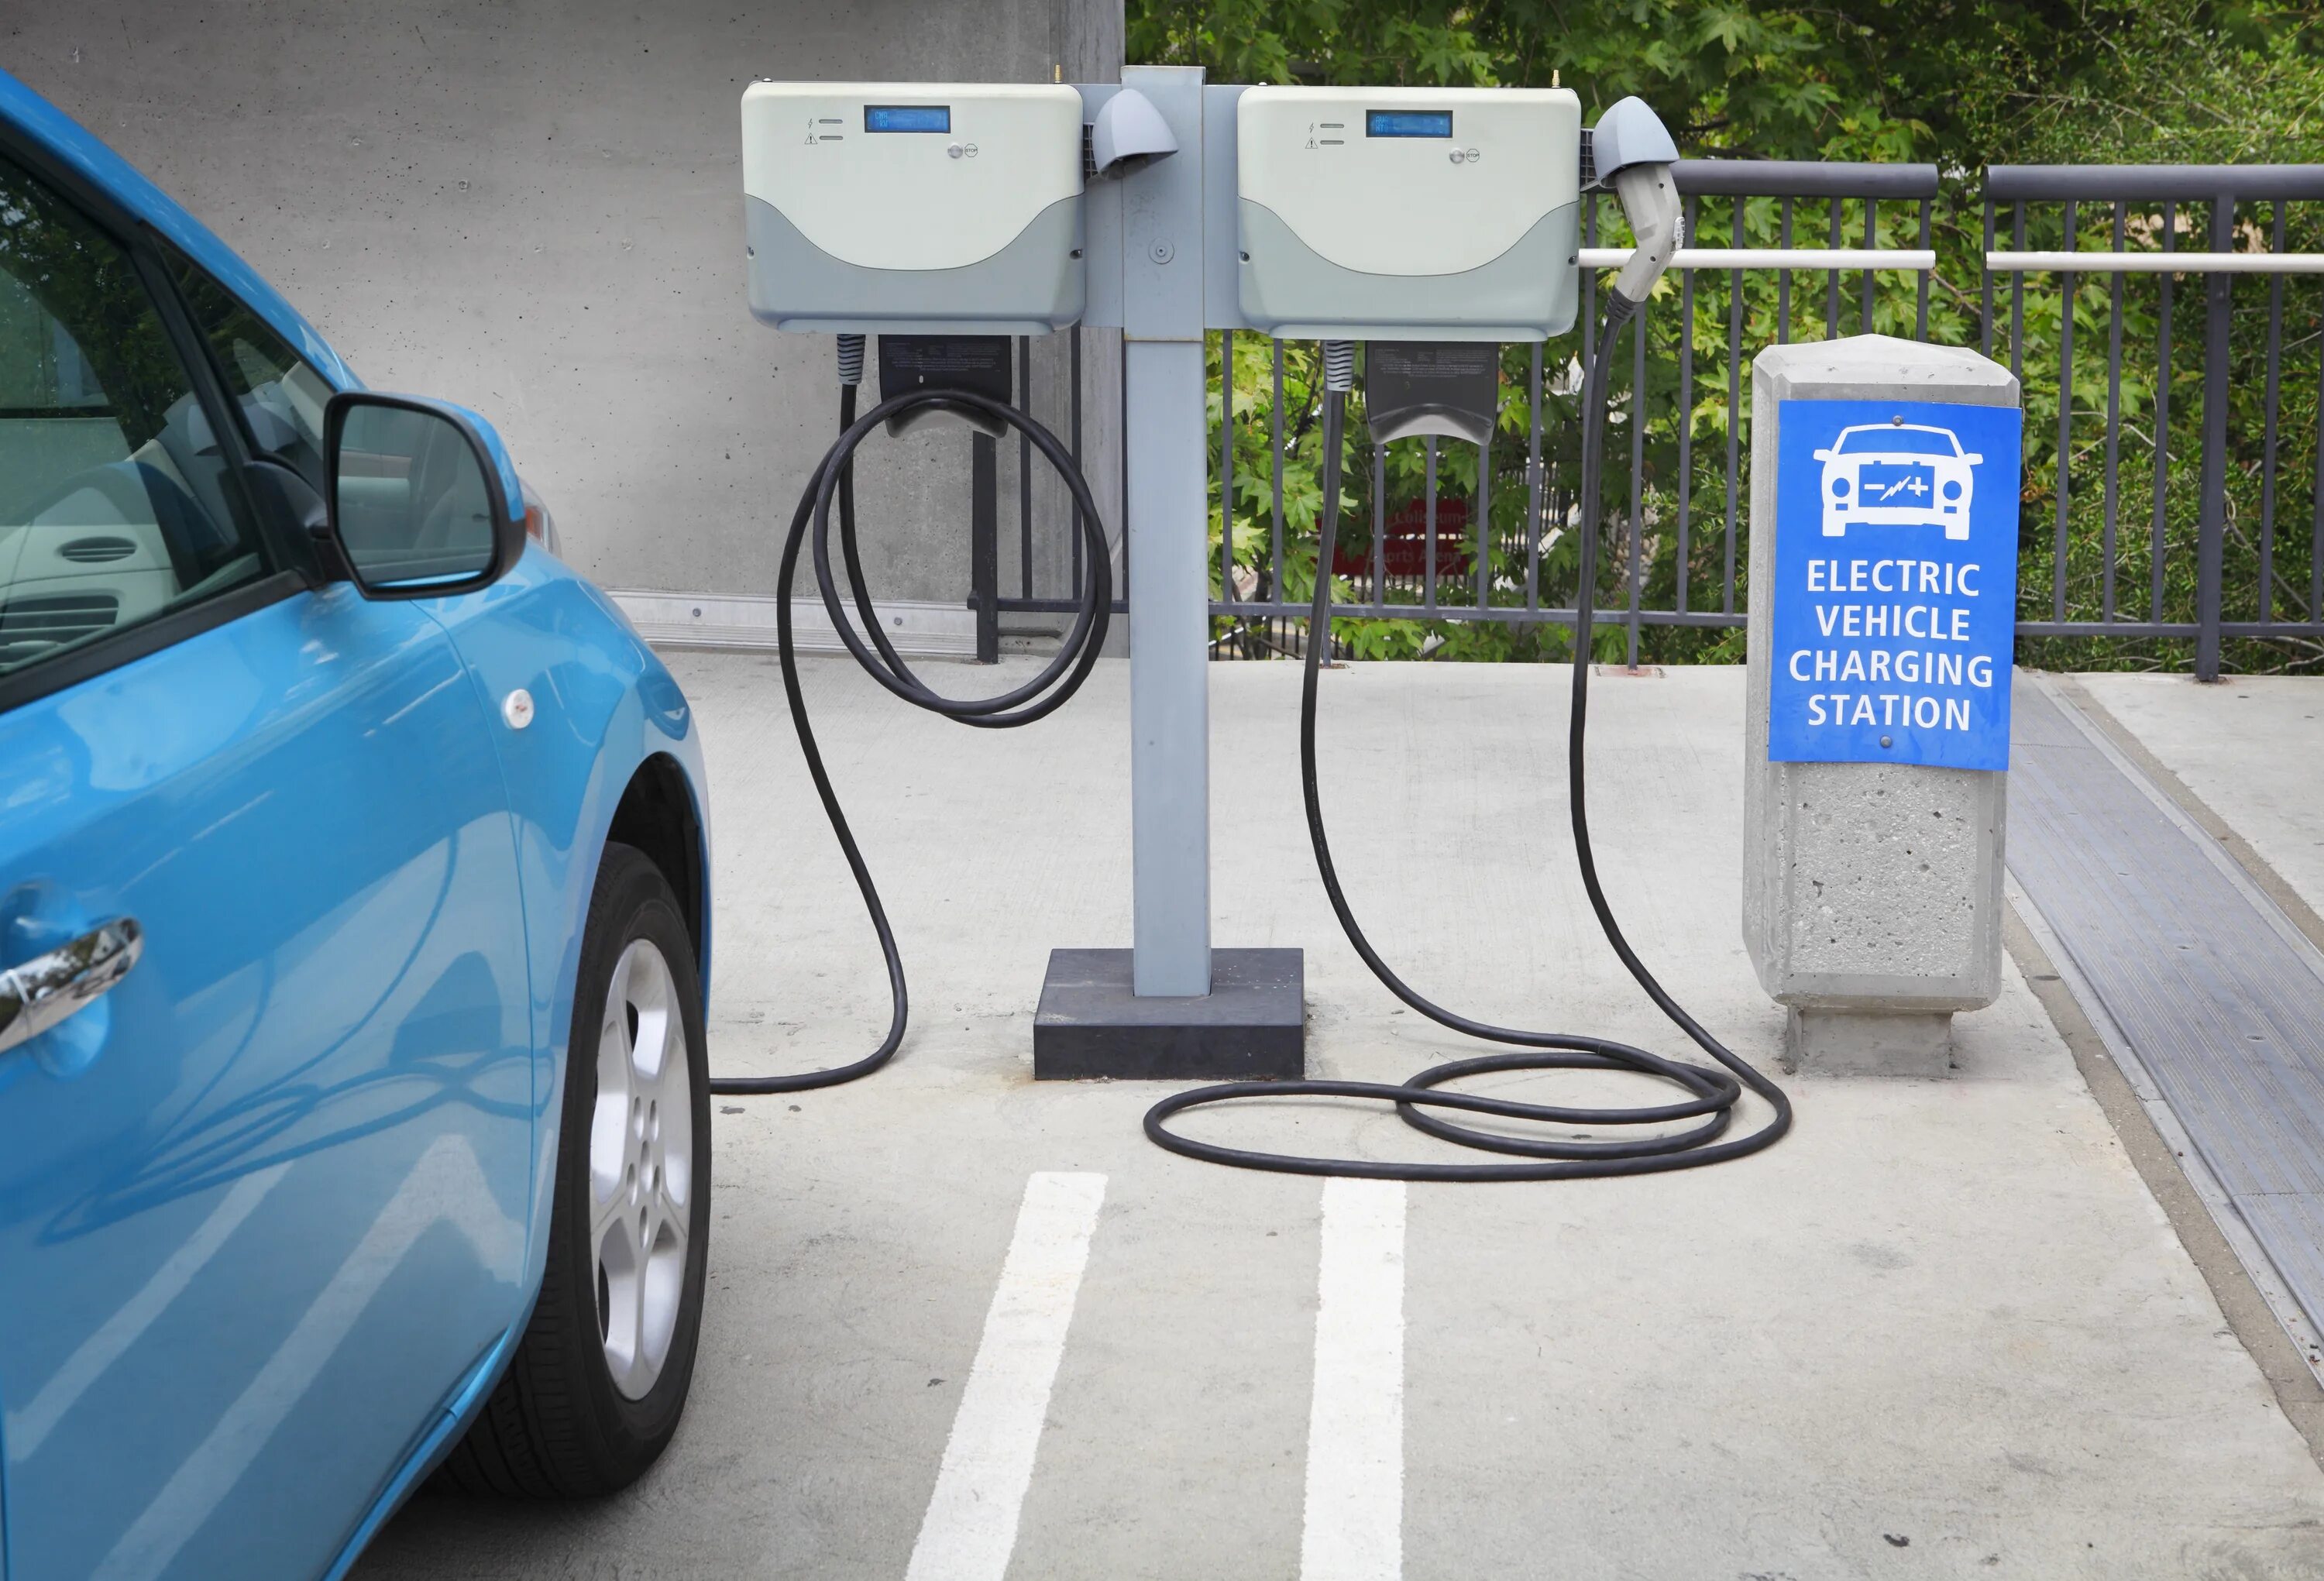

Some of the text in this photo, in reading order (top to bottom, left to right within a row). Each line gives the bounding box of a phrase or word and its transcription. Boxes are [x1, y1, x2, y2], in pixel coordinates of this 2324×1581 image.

[1418, 549, 1461, 563] Aena
[1807, 559, 1980, 596] ELECTRIC
[1815, 605, 1970, 641] VEHICLE
[1789, 649, 1992, 688] CHARGING
[1808, 694, 1970, 731] STATION
